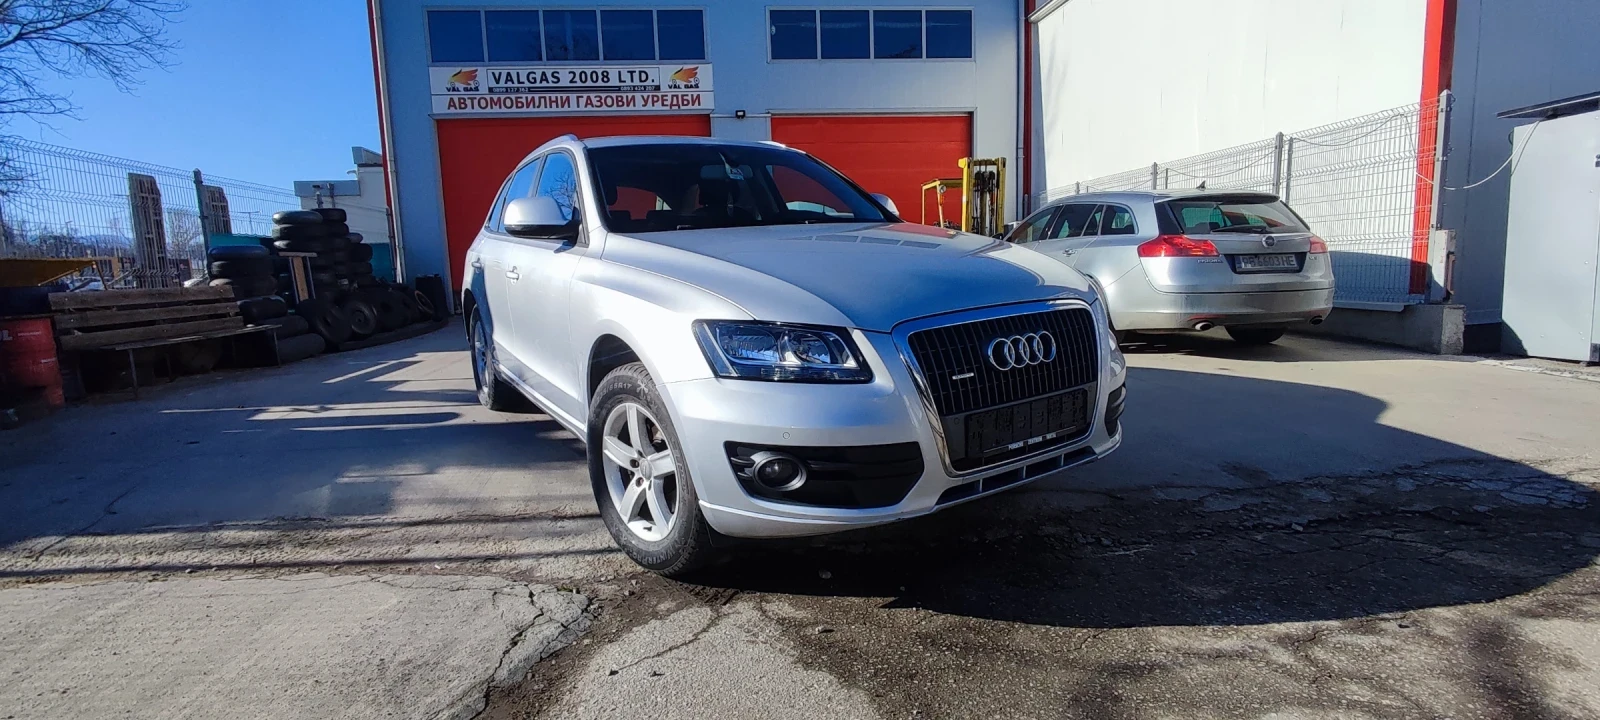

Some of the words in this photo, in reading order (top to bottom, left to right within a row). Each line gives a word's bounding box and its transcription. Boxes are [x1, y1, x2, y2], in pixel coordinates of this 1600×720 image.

[491, 71, 561, 85] VALGAS
[568, 70, 610, 84] 2008
[618, 70, 655, 83] LTD.
[447, 96, 571, 110] АВТОМОБИЛНИ
[576, 95, 636, 109] ГАЗОВИ
[641, 94, 701, 110] УРЕДБИ
